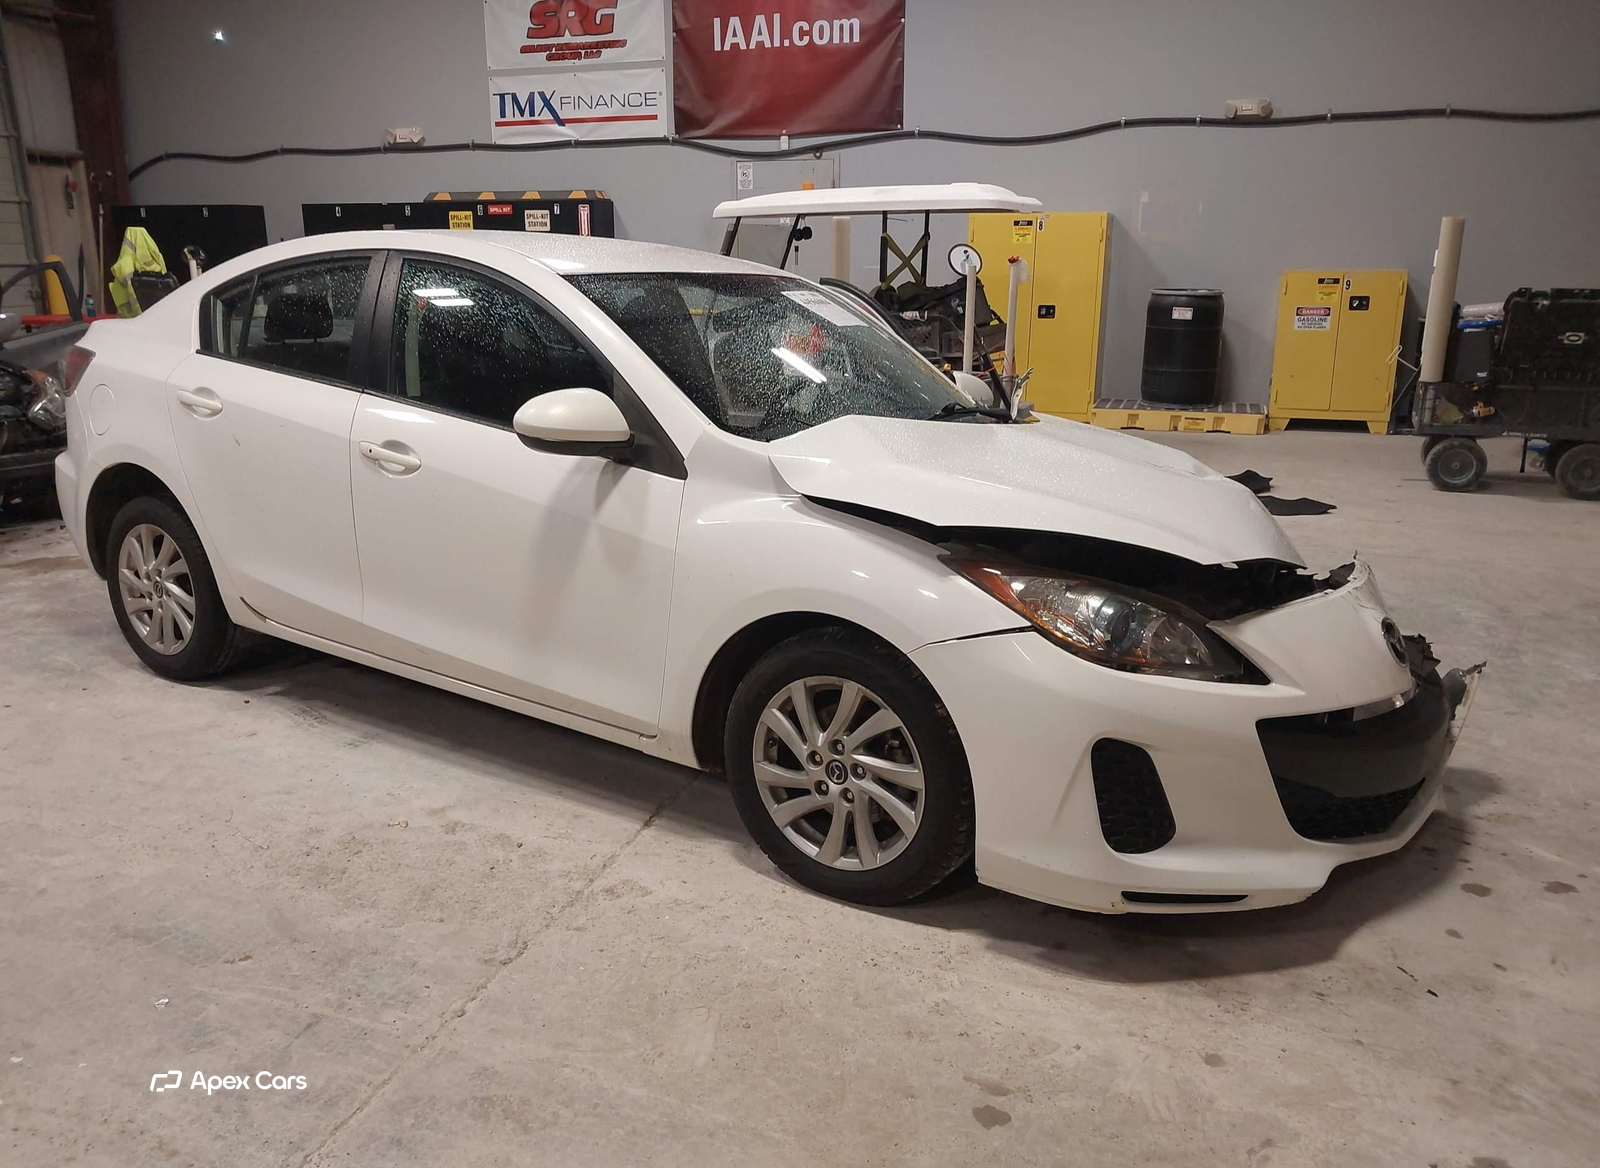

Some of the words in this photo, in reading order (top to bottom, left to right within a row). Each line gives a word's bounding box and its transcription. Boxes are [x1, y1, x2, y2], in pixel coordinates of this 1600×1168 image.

[527, 0, 618, 39] SRG
[713, 13, 860, 51] IAAI.com
[520, 44, 555, 53] SELECT
[555, 39, 627, 51] REMARKETING
[584, 50, 602, 59] LLC
[493, 90, 566, 127] TMX
[560, 91, 658, 111] FINANCE
[1038, 220, 1044, 231] 8
[1345, 280, 1351, 290] 9
